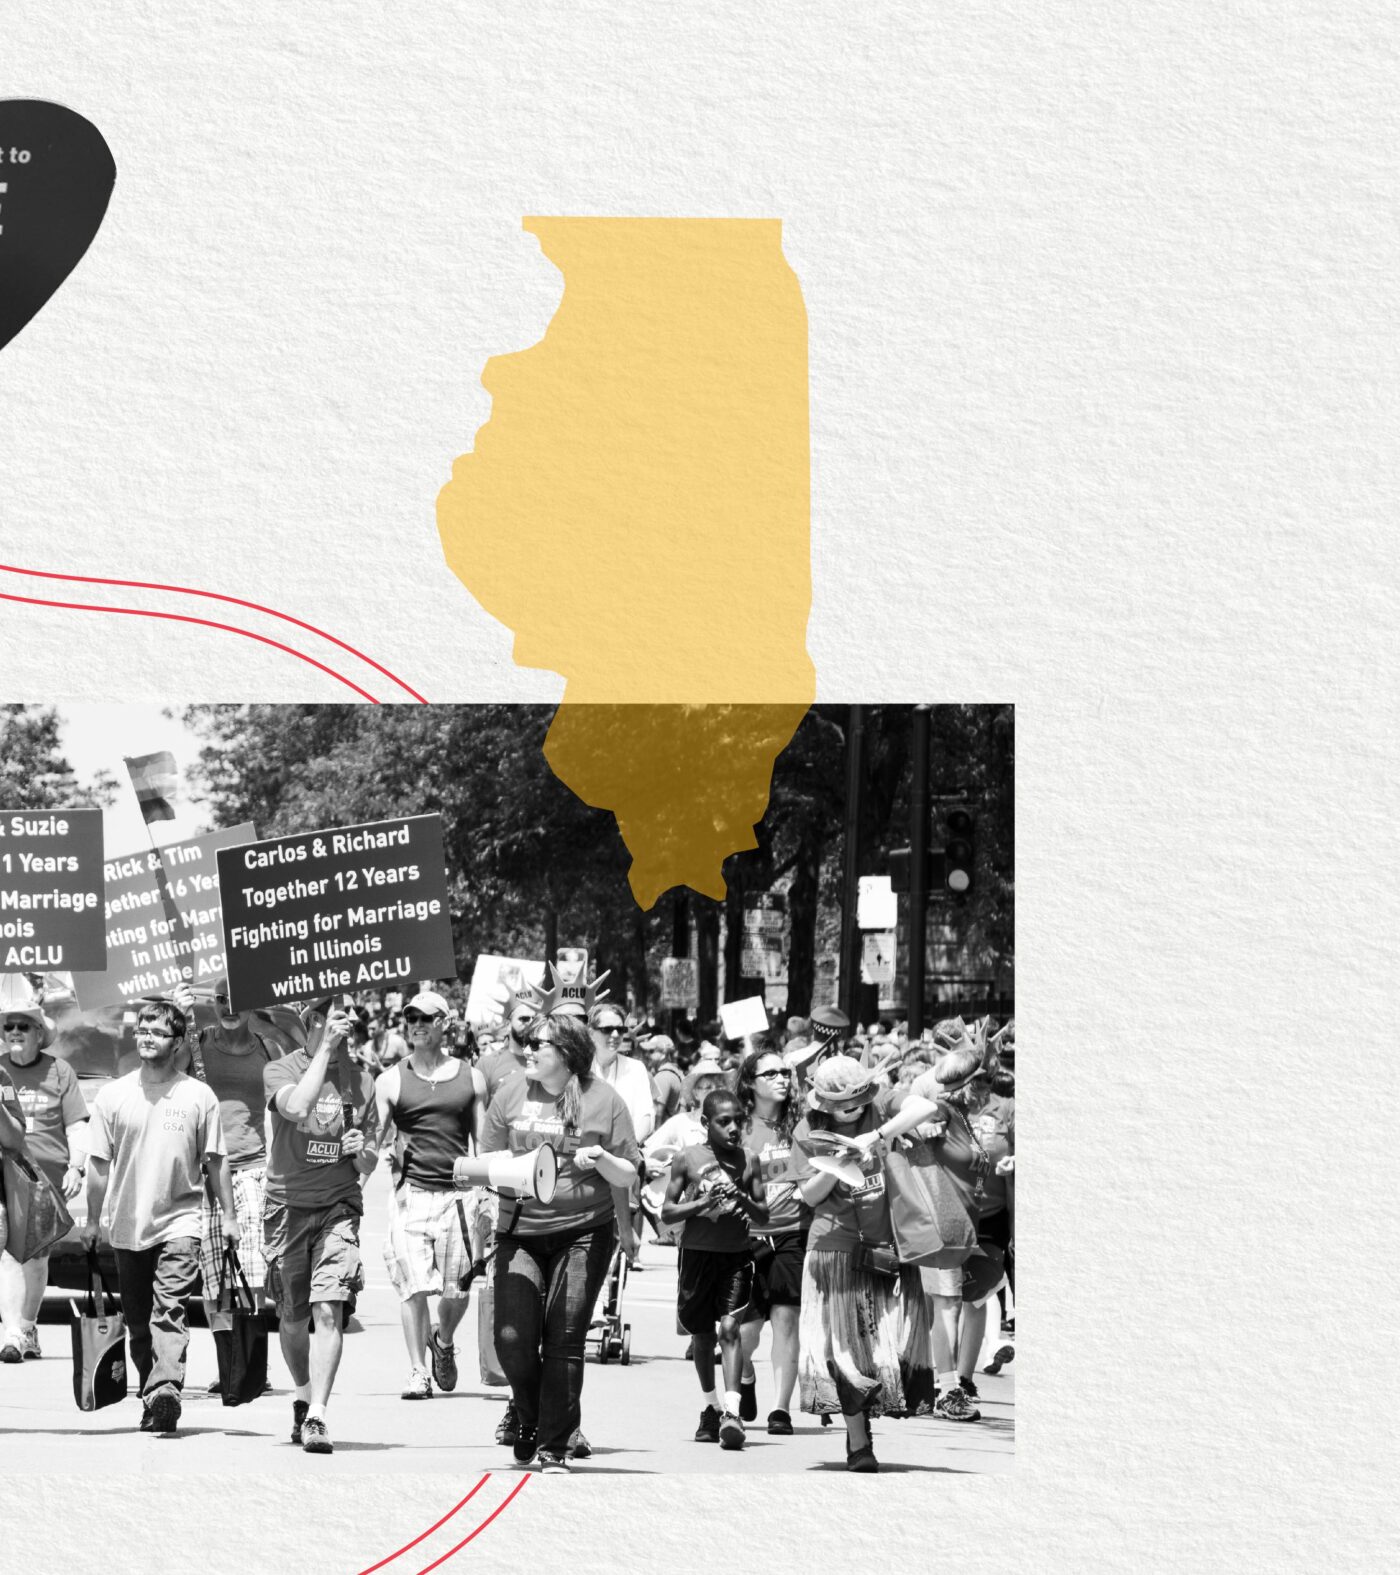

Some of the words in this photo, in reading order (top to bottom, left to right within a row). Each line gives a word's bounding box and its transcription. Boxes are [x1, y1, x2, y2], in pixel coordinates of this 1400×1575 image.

[8, 146, 31, 163] to
[11, 816, 69, 836] Suzie
[19, 853, 79, 872] Years
[244, 842, 307, 870] Carlos
[312, 837, 327, 859] &
[332, 825, 411, 855] Richard
[103, 858, 144, 882] Rick
[147, 852, 162, 871] &
[164, 845, 202, 866] Tim
[1, 889, 98, 912] Marriage
[105, 887, 160, 919] gether
[165, 879, 187, 899] 16
[189, 873, 219, 893] Yea
[242, 876, 329, 909] Together
[334, 871, 359, 891] 12
[362, 862, 420, 887] Years
[106, 926, 147, 948] ting
[150, 918, 177, 937] for
[230, 917, 309, 949] Fighting
[313, 912, 342, 932] for
[347, 898, 441, 928] Marriage
[5, 945, 63, 966] ACLU
[131, 950, 151, 967] in
[153, 932, 218, 962] Illinois
[290, 946, 309, 965] in
[313, 934, 382, 962] Illinois
[117, 972, 160, 996] with
[162, 965, 193, 985] the
[198, 952, 227, 976] AC
[271, 974, 315, 998] with
[318, 968, 351, 991] the
[356, 956, 412, 983] ACLU
[561, 987, 587, 999] ACLU
[163, 1121, 185, 1132] GSA
[165, 1108, 187, 1119] BHS
[310, 1144, 337, 1155] ACLU
